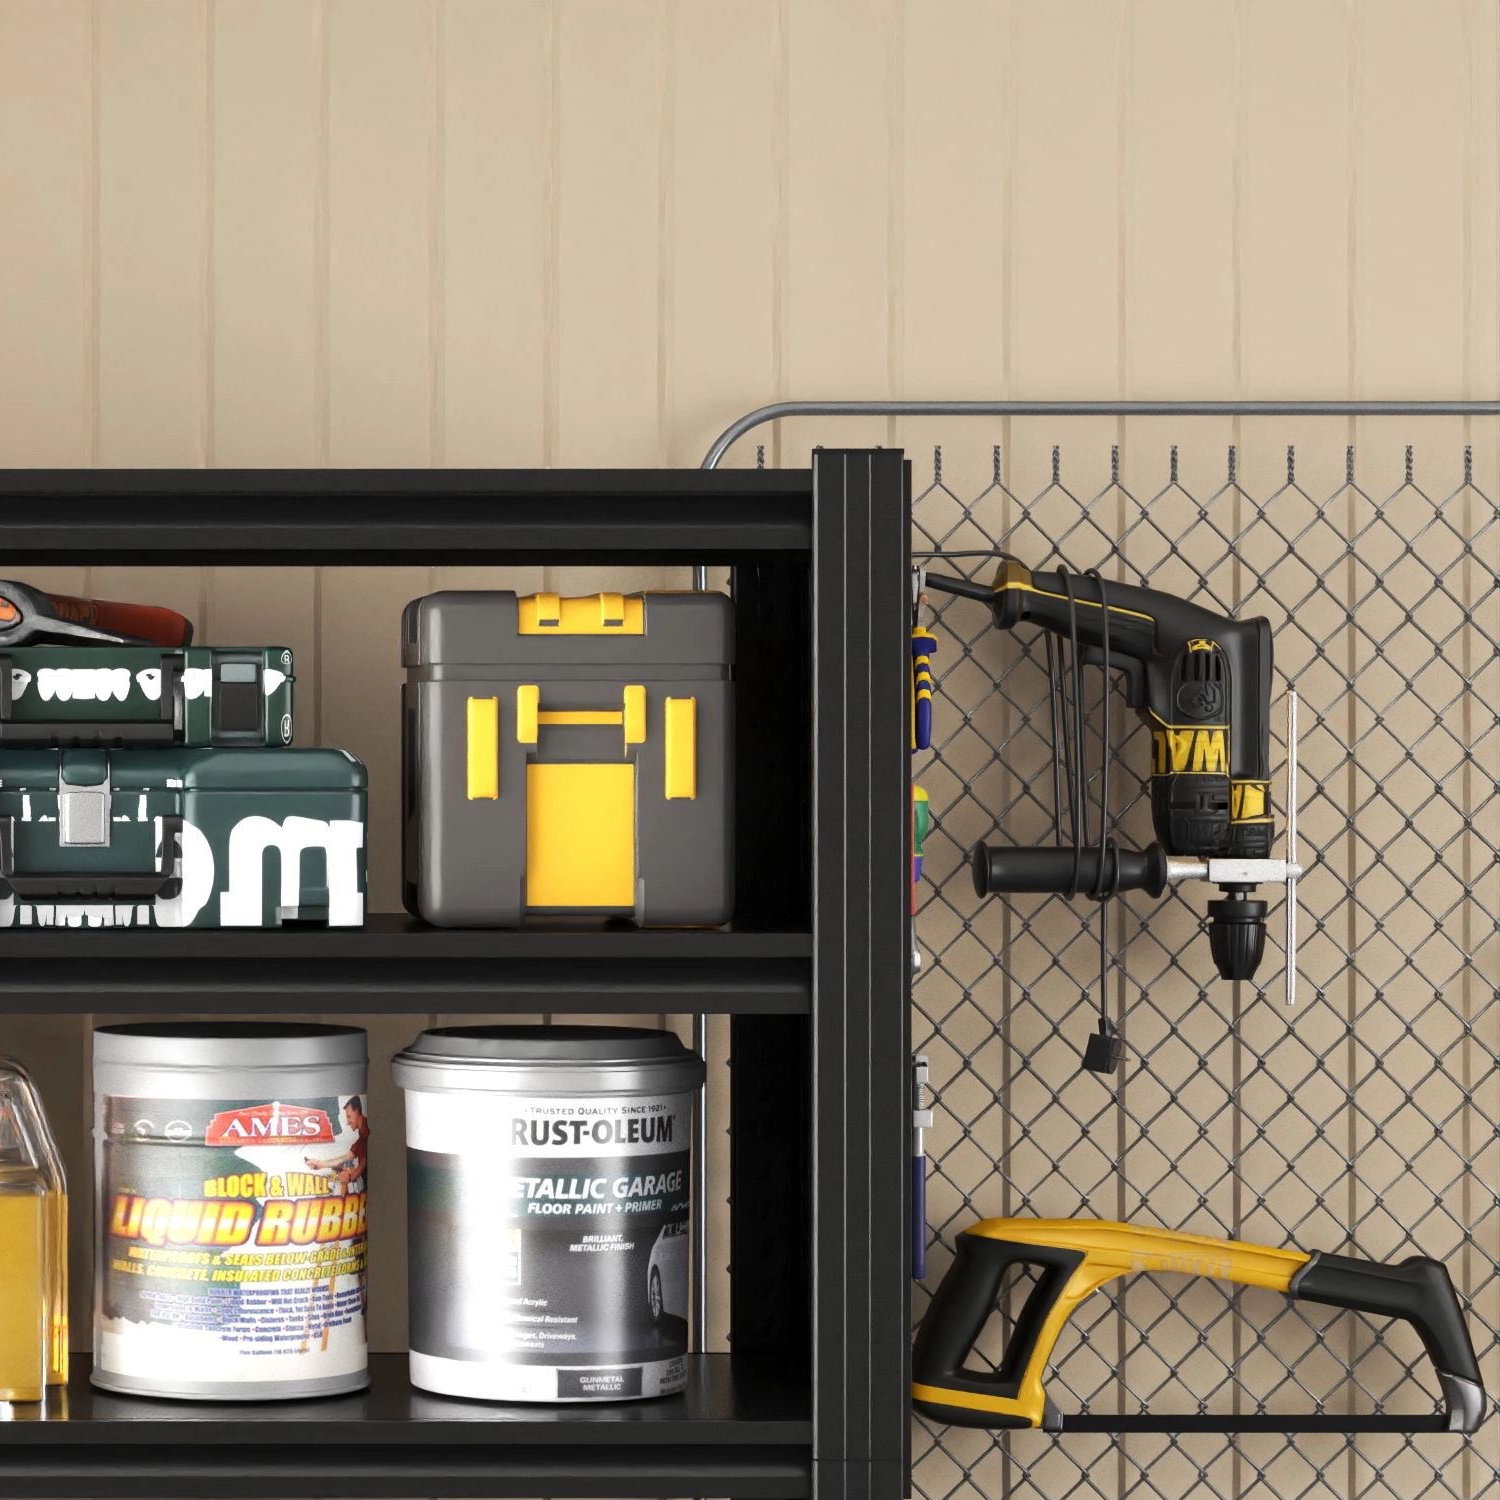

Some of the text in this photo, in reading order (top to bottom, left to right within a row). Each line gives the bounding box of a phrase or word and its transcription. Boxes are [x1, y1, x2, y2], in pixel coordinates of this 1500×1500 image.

[530, 1104, 664, 1116] TRUSTED QUALITY SINCE 1921
[221, 1116, 321, 1138] AMES
[511, 1115, 673, 1147] RUST-OLEUM
[203, 1172, 330, 1198] BLOCK & WALL
[514, 1170, 682, 1199] ETALLIC GARAGE
[527, 1202, 571, 1215] FLOOR
[575, 1202, 614, 1215] PAINT
[624, 1199, 663, 1213] PRIMER
[110, 1194, 258, 1247] LIQUID
[569, 1242, 635, 1252] METALLIC FINISH
[225, 1253, 263, 1267] SEALS
[211, 1268, 281, 1283] INSULATED
[282, 1264, 337, 1282] CONCRETE
[523, 1298, 548, 1308] Acrylic
[544, 1315, 579, 1324] Resistant
[580, 1375, 624, 1385] GUNMETAL
